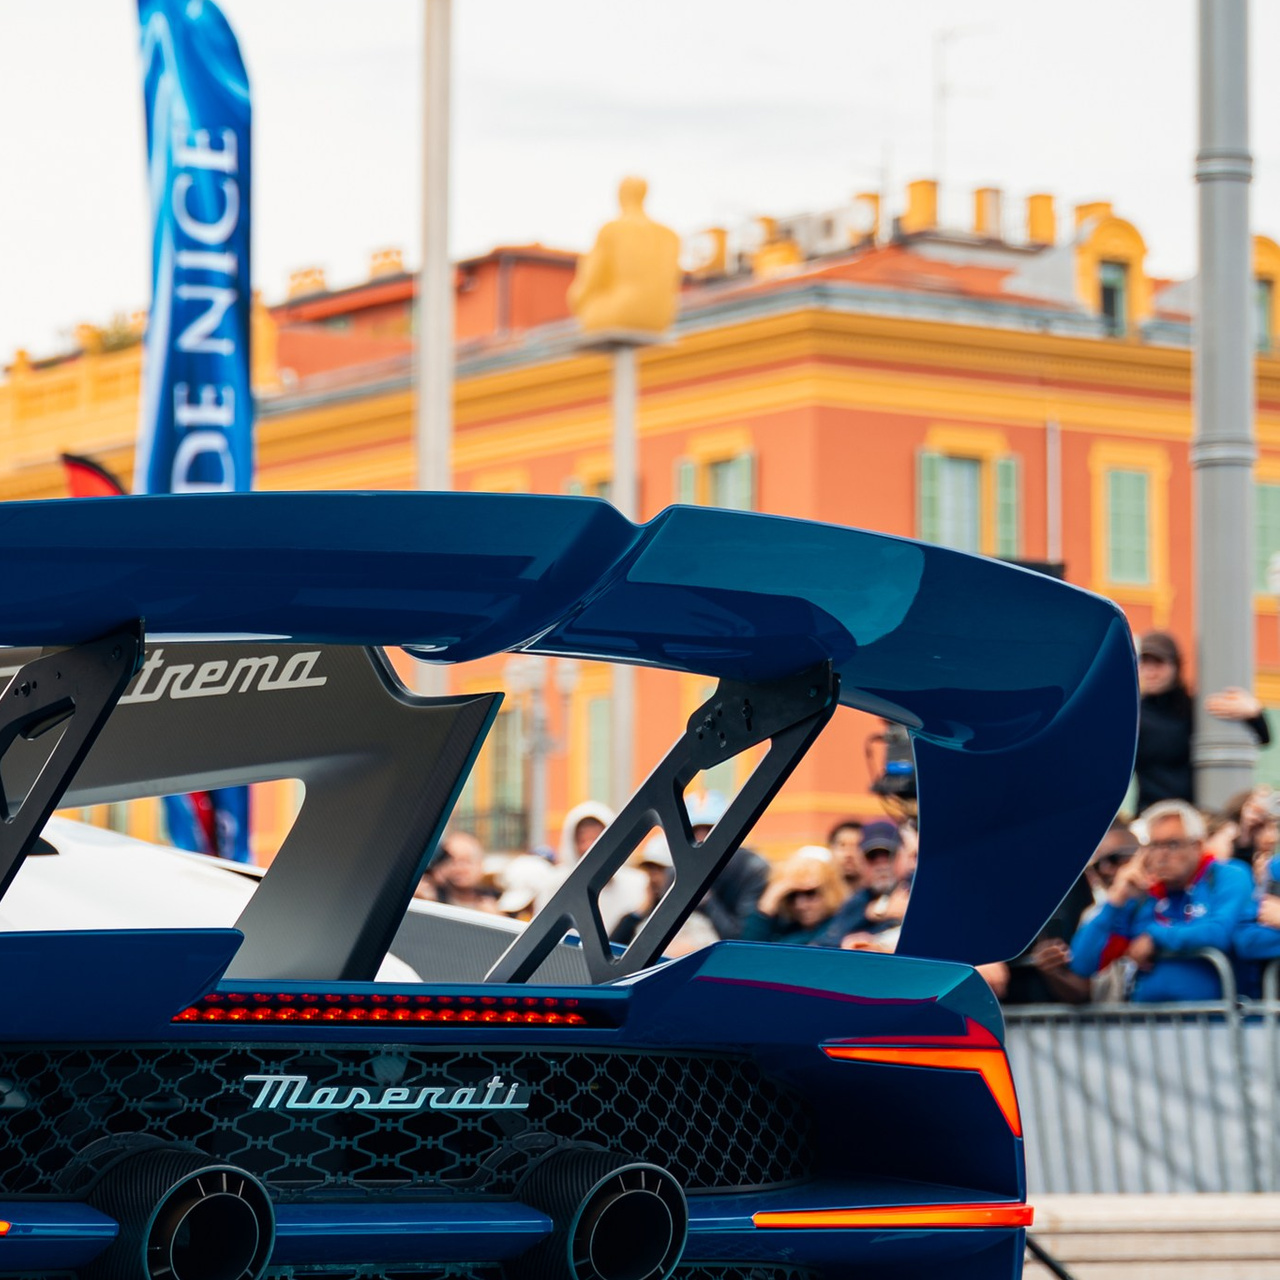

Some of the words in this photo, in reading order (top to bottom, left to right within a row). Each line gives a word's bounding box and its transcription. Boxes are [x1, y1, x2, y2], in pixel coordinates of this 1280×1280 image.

[170, 125, 241, 357] NICE
[170, 382, 237, 493] DE
[243, 1074, 530, 1110] Maserati
